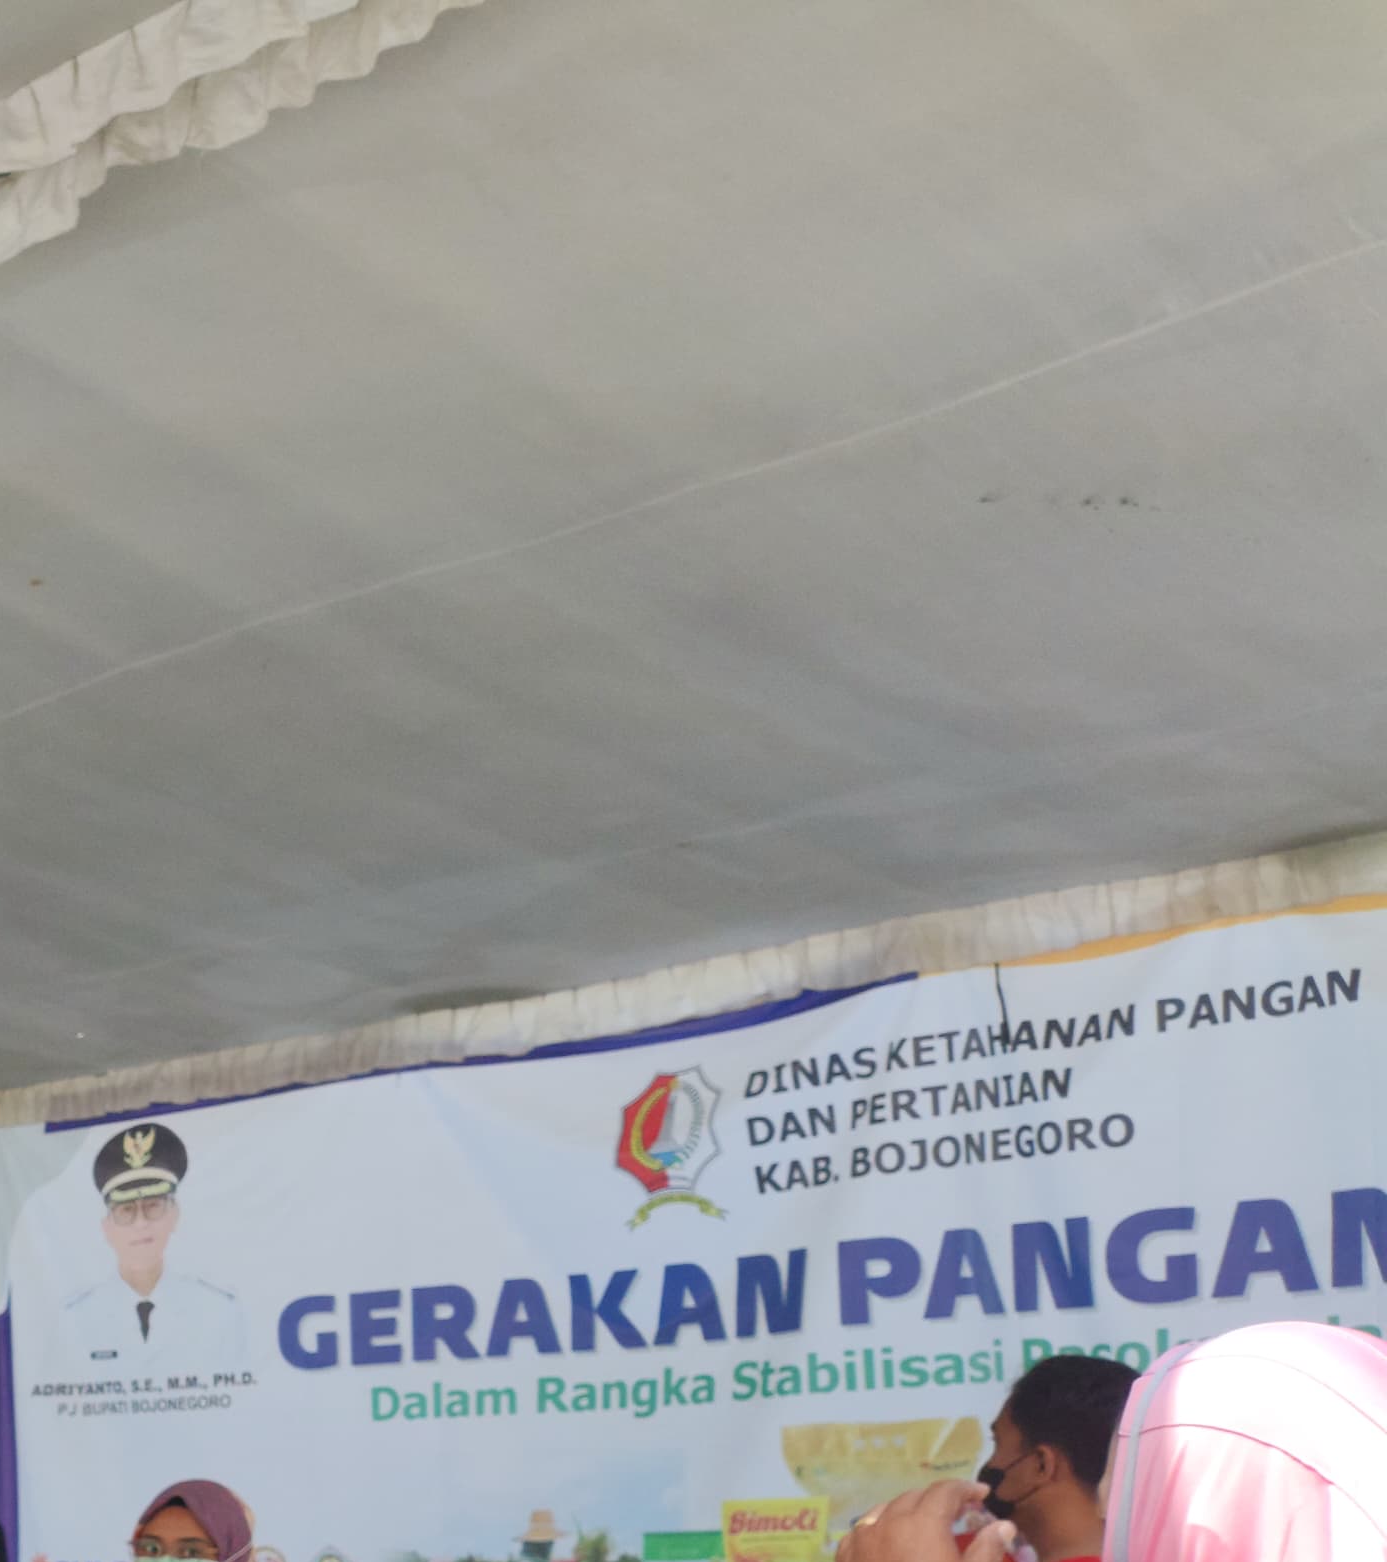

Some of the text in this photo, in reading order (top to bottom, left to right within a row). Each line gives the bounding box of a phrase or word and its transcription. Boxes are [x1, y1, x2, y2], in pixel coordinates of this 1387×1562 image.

[743, 967, 1362, 1099] DINAS KETAHANAN PANGAN
[747, 1067, 1073, 1148] DAN PERTANIAN
[754, 1112, 1136, 1195] KAB. BOJONEGORO
[277, 1186, 1387, 1371] GERAKAN PANGAN
[369, 1381, 518, 1422] Dalam
[536, 1366, 716, 1418] Rangka
[731, 1339, 1005, 1401] Stabilisasi
[729, 1509, 819, 1534] Bimoli
